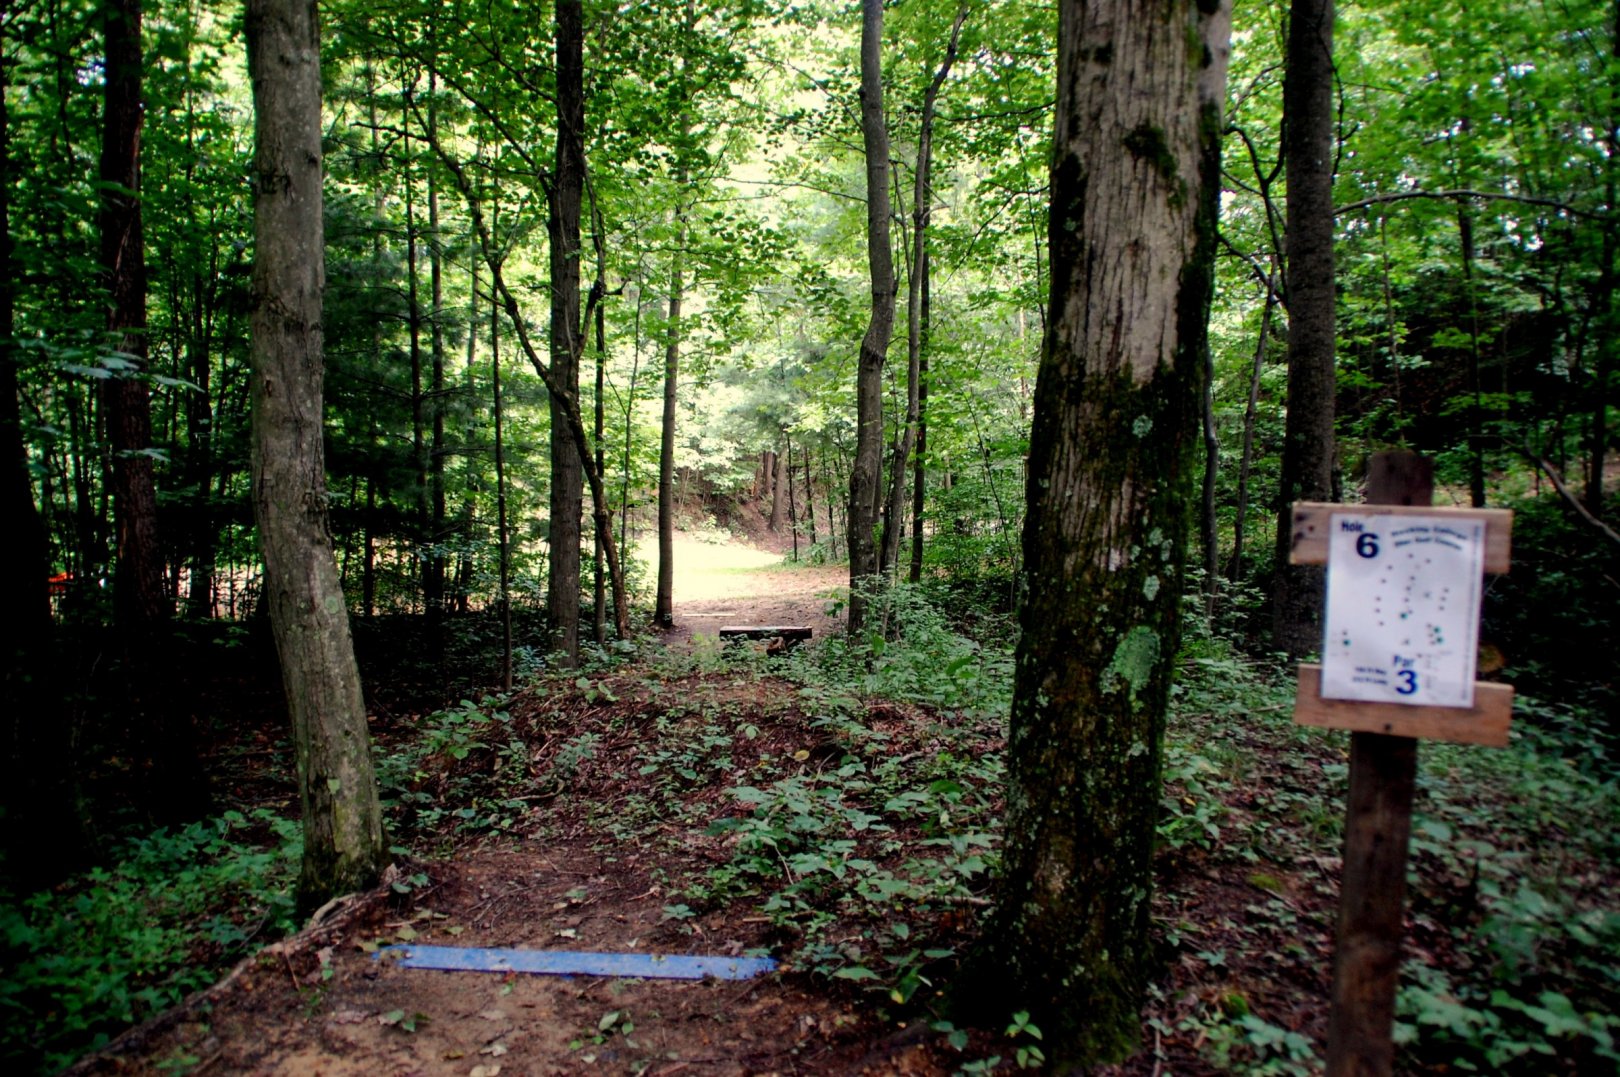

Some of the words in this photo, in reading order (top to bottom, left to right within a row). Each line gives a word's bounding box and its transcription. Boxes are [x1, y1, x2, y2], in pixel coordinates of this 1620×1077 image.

[1341, 520, 1364, 532] Hole
[1356, 533, 1379, 558] 6
[1393, 655, 1415, 667] Par
[1396, 670, 1417, 694] 3
